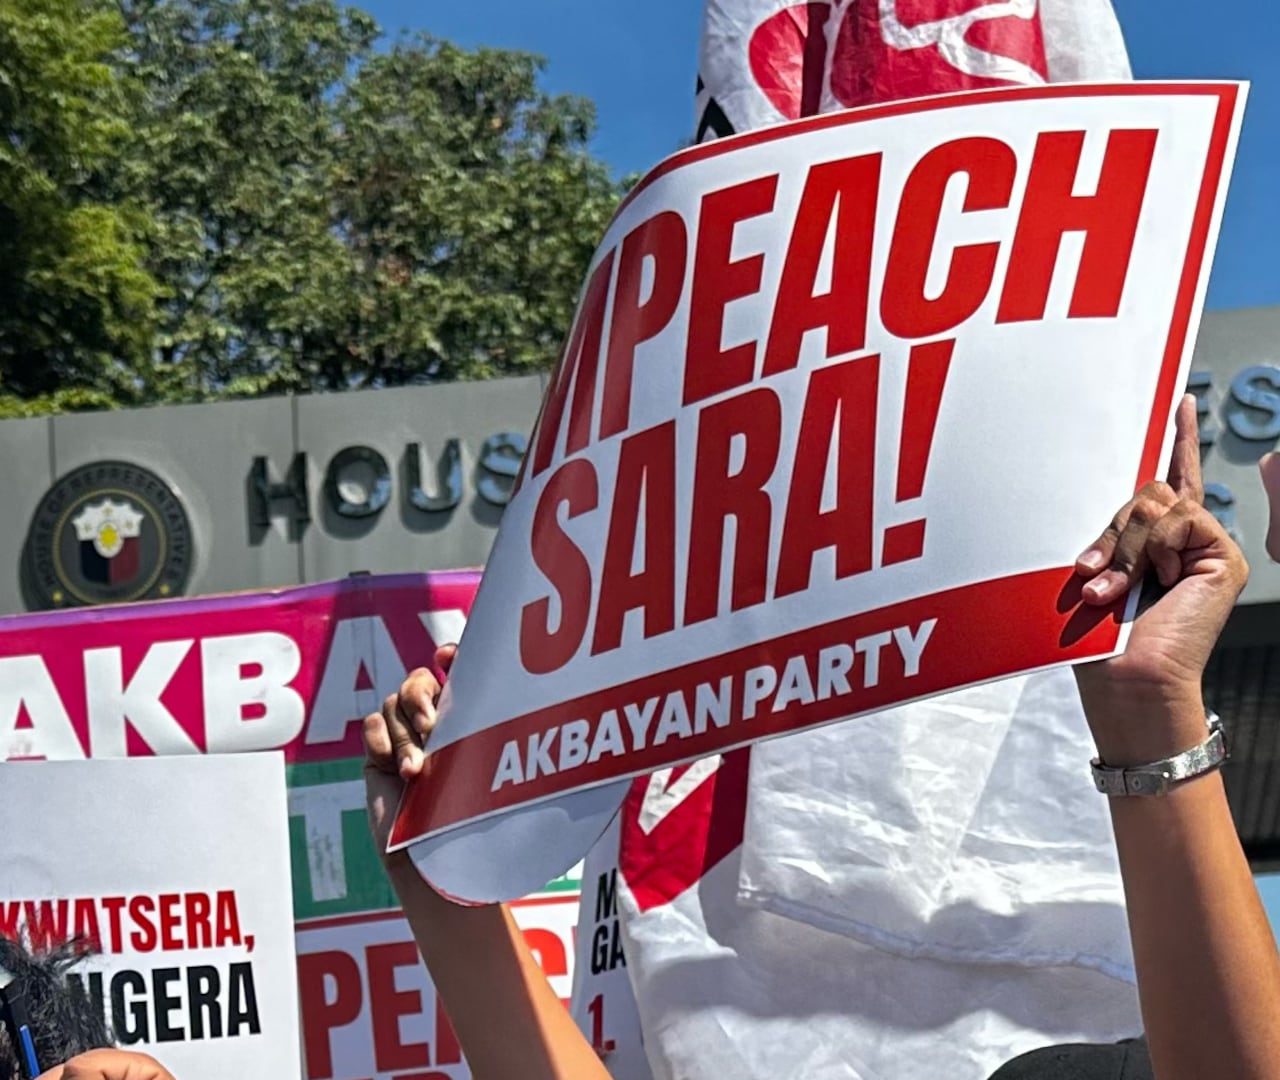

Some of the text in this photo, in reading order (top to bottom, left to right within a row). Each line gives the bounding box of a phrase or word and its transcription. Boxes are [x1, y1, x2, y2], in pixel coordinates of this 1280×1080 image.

[519, 338, 955, 676] SARA!
[491, 618, 938, 794] AKBAYAN PARTY
